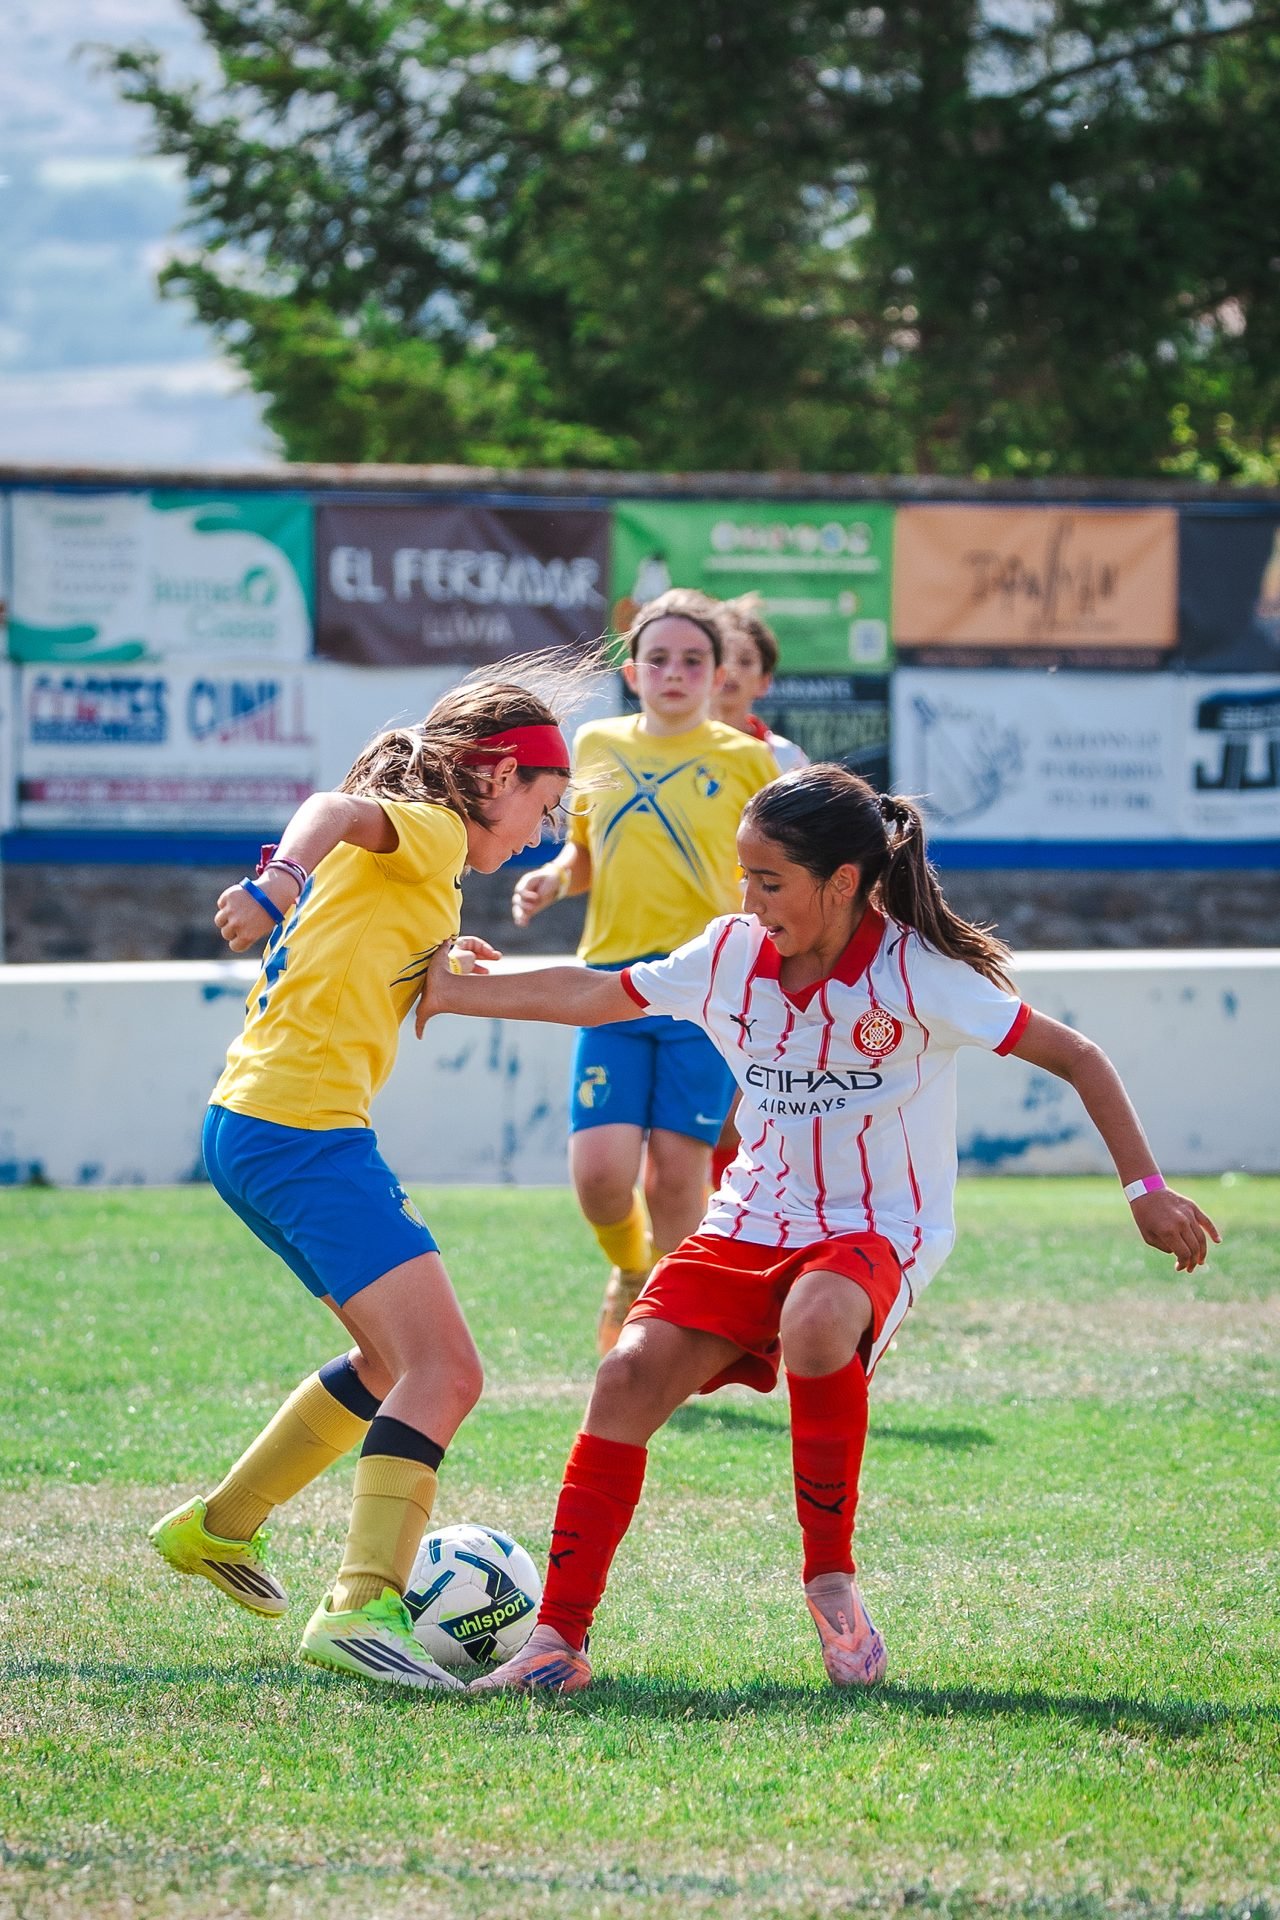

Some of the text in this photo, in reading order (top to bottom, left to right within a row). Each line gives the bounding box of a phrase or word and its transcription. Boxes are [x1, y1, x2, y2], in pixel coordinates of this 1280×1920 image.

[329, 546, 386, 603] EL
[860, 1010, 892, 1024] GIRONA
[745, 1063, 883, 1093] ETIHAD
[758, 1097, 846, 1115] AIRWAYS
[453, 1593, 528, 1638] uhlsport
